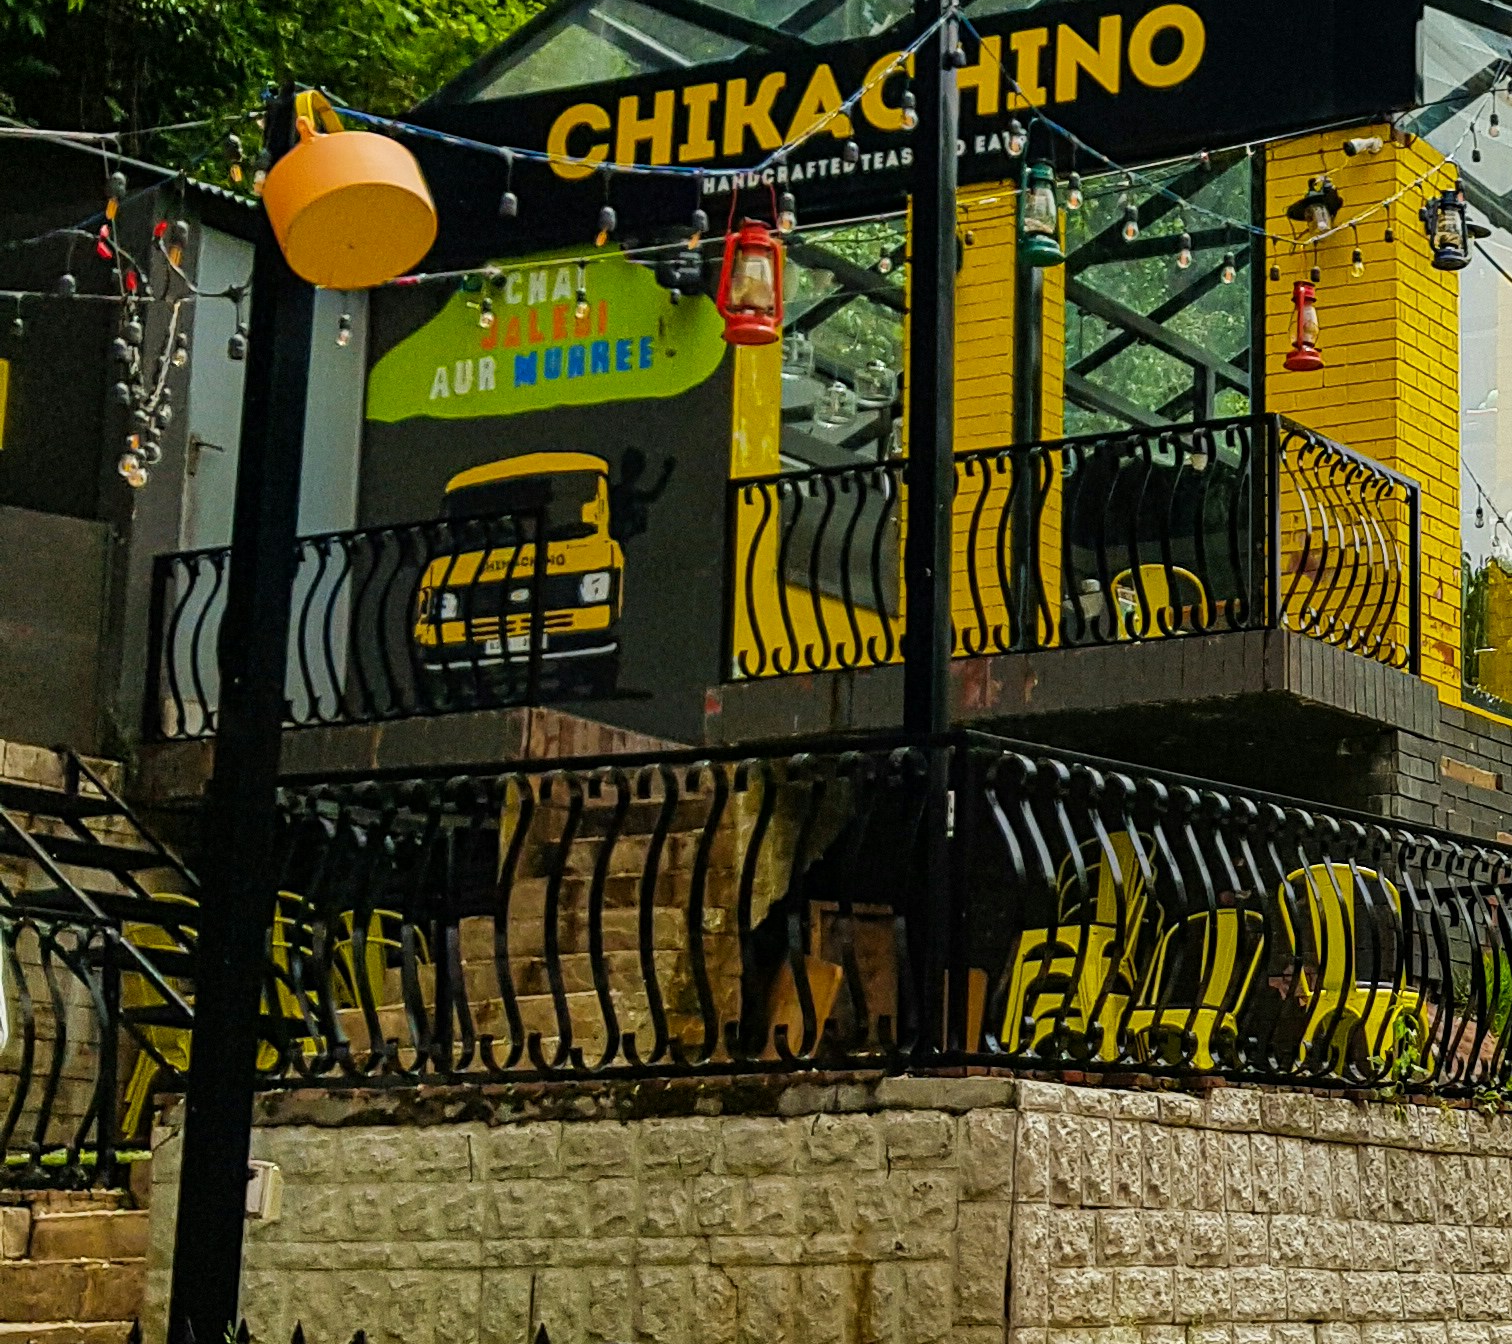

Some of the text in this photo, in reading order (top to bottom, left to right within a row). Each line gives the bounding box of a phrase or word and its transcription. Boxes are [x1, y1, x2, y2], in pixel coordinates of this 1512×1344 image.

[547, 3, 1206, 181] CHIKACHINO
[861, 148, 914, 173] TEAS
[505, 266, 587, 306] CHAI
[429, 335, 654, 400] AUR MURREE
